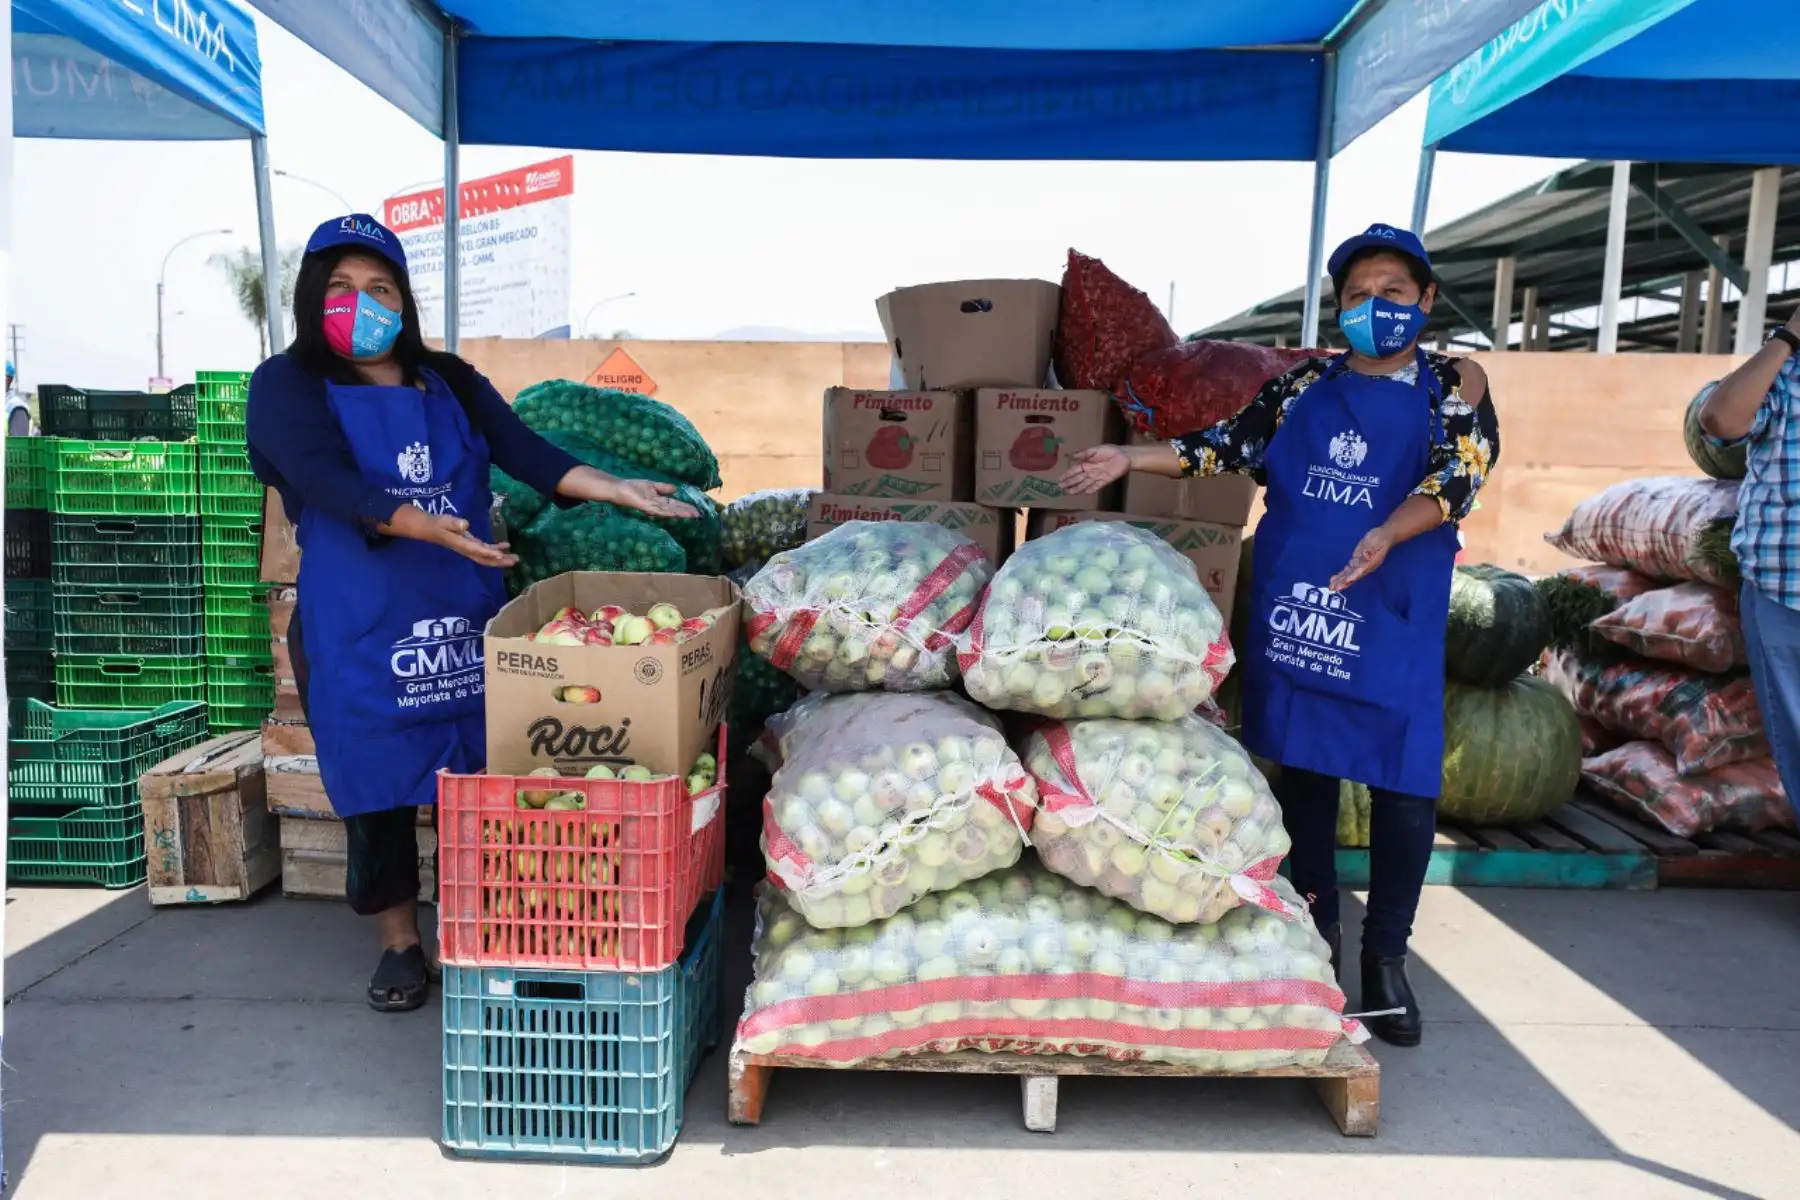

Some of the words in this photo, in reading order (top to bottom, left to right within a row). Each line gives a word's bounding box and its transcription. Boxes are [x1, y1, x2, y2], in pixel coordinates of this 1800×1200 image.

[391, 199, 431, 226] OBRA
[341, 217, 384, 239] LIMA
[499, 226, 539, 245] MERCADO
[597, 374, 642, 385] PELIGRO
[853, 393, 934, 411] Pimiento
[997, 393, 1080, 412] Pimiento
[1302, 476, 1374, 510] LIMA
[820, 503, 902, 523] Pimiento
[1269, 605, 1360, 651] GMML
[391, 639, 485, 677] GMML
[497, 651, 559, 673] PERAS
[681, 643, 712, 669] PERAS
[1265, 647, 1306, 669] Mayorista
[1310, 661, 1323, 673] de
[1326, 664, 1351, 681] Lima
[1272, 637, 1295, 652] Gran
[1298, 645, 1343, 666] Mercado
[397, 689, 451, 708] Mayorista
[455, 687, 467, 698] de
[471, 683, 485, 695] Lim
[406, 682, 432, 694] Gran
[438, 672, 481, 690] Mercado
[527, 715, 631, 757] Roci
